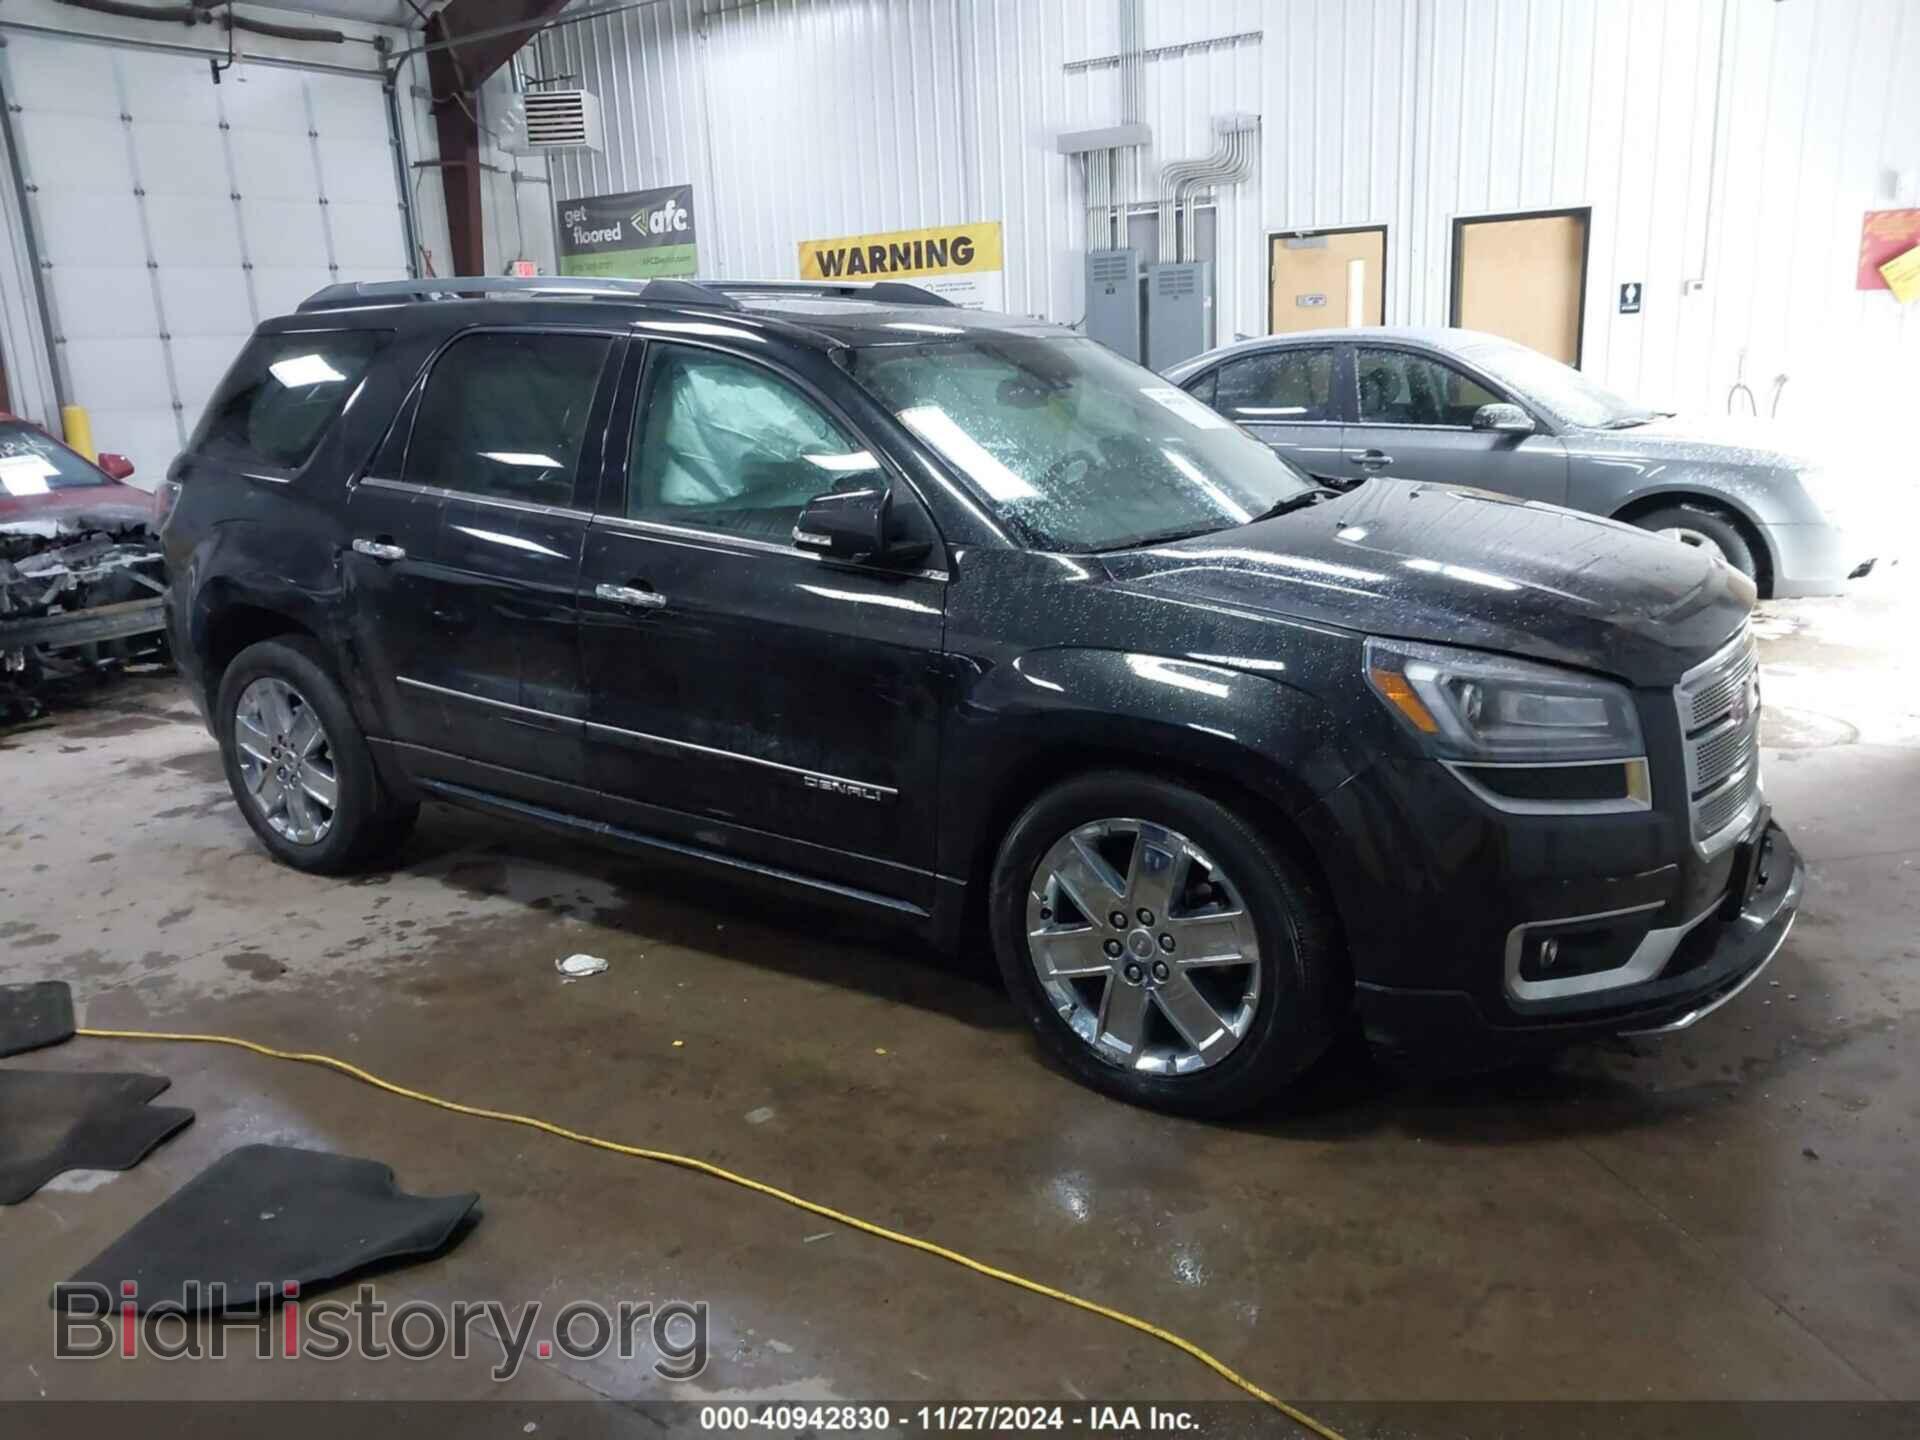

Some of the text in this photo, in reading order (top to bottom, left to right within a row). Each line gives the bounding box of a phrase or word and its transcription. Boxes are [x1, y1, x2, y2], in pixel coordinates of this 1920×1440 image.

[564, 205, 587, 228] get
[649, 199, 688, 234] afc
[573, 222, 622, 245] floored
[815, 236, 975, 278] WARNING
[803, 776, 881, 801] DENALI
